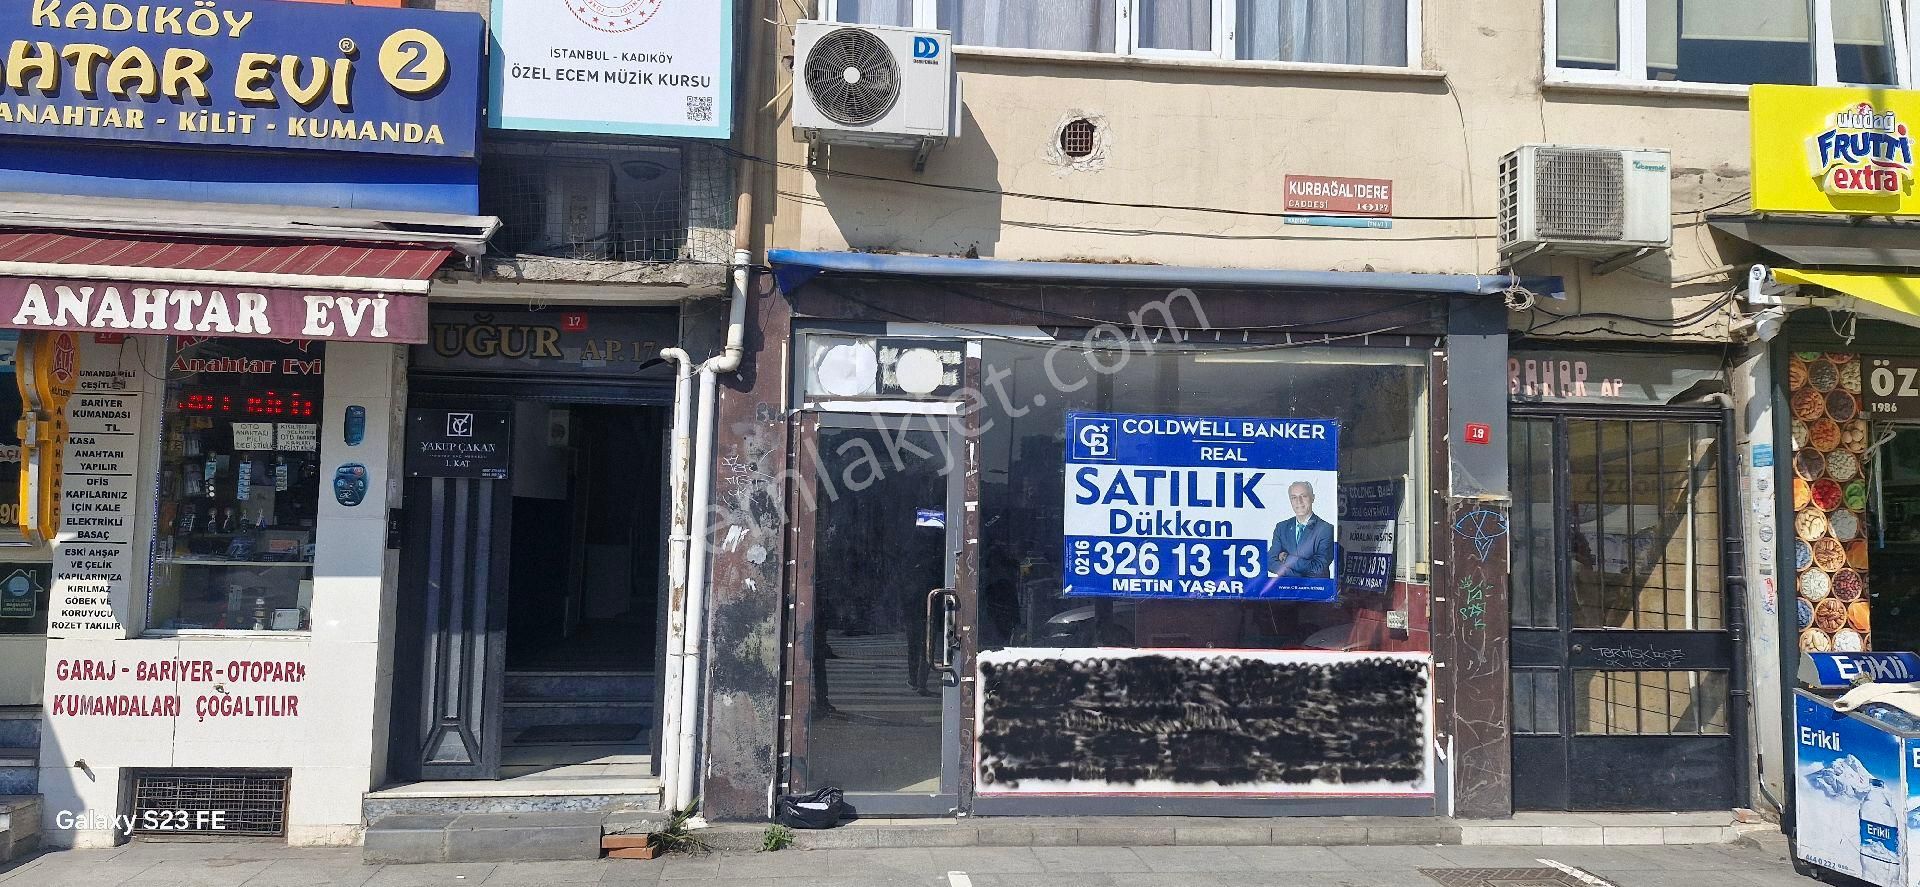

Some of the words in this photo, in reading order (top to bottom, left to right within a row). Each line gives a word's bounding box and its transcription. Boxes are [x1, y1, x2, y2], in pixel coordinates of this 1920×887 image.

[32, 0, 253, 38] KADIKÖY
[550, 47, 610, 61] İSTANBUL
[621, 52, 674, 64] KADIKÖY
[0, 40, 208, 99] HTAR
[396, 41, 428, 80] 2
[511, 62, 552, 82] ÖZEL
[556, 68, 599, 83] ECEM
[604, 69, 653, 85] MÜZİK
[658, 73, 711, 88] KURSU
[288, 118, 445, 145] KUMANDA
[1834, 165, 1898, 192] extra
[1289, 181, 1389, 199] KURBAĞALIDERE
[1288, 199, 1328, 209] CADDESİ
[12, 283, 272, 334] ANAHTAR
[302, 293, 390, 338] EVİ
[568, 316, 581, 327] 17
[433, 313, 563, 359] UĞUR
[169, 354, 277, 375] Anahtar
[282, 358, 322, 376] Evi
[80, 370, 115, 378] UMANDA
[1507, 356, 1588, 398] BAHAR
[1601, 378, 1624, 397] AP
[81, 398, 123, 408] BARİYER
[1871, 403, 1898, 413] 1986
[72, 410, 131, 419] KUMANDASI
[105, 424, 120, 432] TL
[1122, 419, 1237, 438] COLDWELL
[1242, 422, 1325, 440] BANKER
[69, 437, 96, 445] KASA
[421, 441, 457, 452] YAKUP
[458, 443, 495, 453] ÇAKAN
[75, 450, 124, 458] ANAHTARI
[1200, 446, 1248, 462] REAL
[80, 463, 117, 471] YAPILIR
[86, 477, 109, 486] OFİS
[1075, 466, 1266, 509] SATILIK
[65, 490, 128, 499] KAPILARINIZ
[72, 502, 92, 513] İÇİN
[95, 503, 121, 512] KALE
[66, 517, 123, 526] ELEKTRİKLİ
[1109, 508, 1233, 538] Dükkan
[77, 531, 110, 540] BASAÇ
[65, 548, 86, 556] ESKİ
[89, 549, 120, 558] AHŞAP
[71, 561, 83, 569] VE
[85, 560, 112, 570] ÇELİK
[1075, 540, 1090, 576] 0216
[1093, 541, 1160, 576] 326
[1171, 542, 1211, 577] 13
[1223, 544, 1261, 579] 13
[58, 573, 122, 581] KAPILARINIZA
[67, 585, 111, 593] KIRILMAZ
[1179, 580, 1244, 596] YAŞAR
[65, 597, 97, 605] GÖBEK
[61, 609, 113, 617] KORUYUCU
[51, 621, 83, 629] ROZET
[85, 622, 121, 630] TAKILIR
[56, 659, 116, 681] GARAJ
[136, 656, 213, 682] BARİYER
[227, 661, 306, 682] OTOPARK
[1831, 655, 1909, 680] Erikli
[53, 694, 181, 717] KUMANDALARI
[1800, 726, 1841, 752] Erikli
[1867, 823, 1891, 840] Erikli
